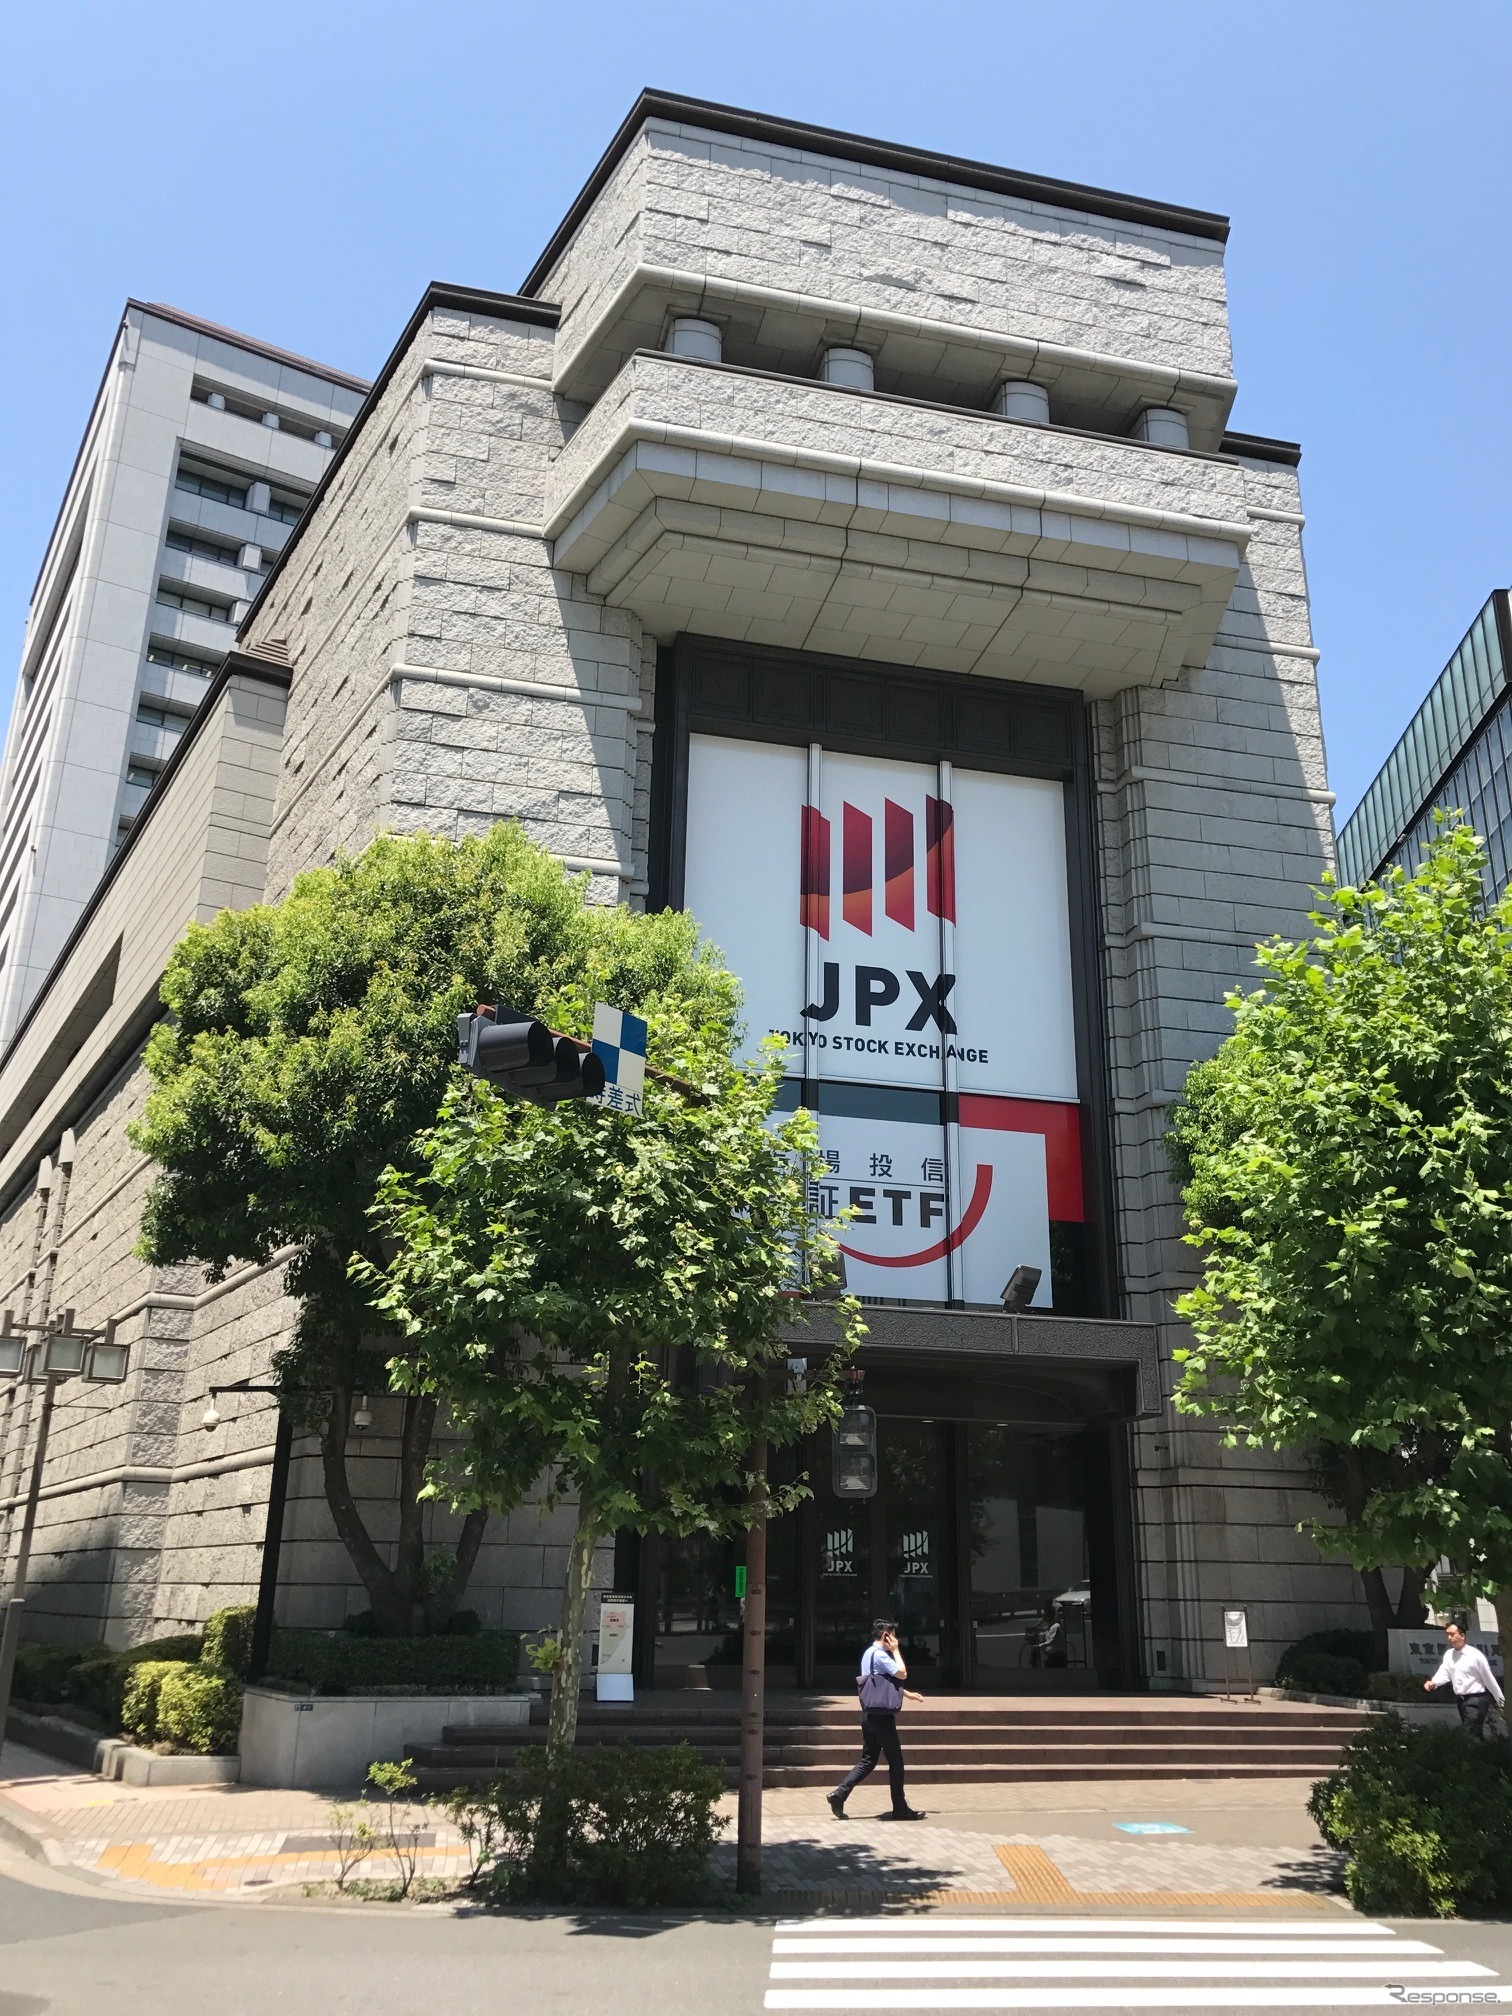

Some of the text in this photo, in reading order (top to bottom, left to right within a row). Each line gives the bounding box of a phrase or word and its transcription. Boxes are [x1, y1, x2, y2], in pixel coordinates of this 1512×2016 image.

[799, 961, 958, 1036] JPX
[832, 1036, 890, 1055] STOCK
[894, 1041, 989, 1064] EXCHANGE
[827, 1560, 853, 1573] JPX
[903, 1562, 929, 1574] JPX
